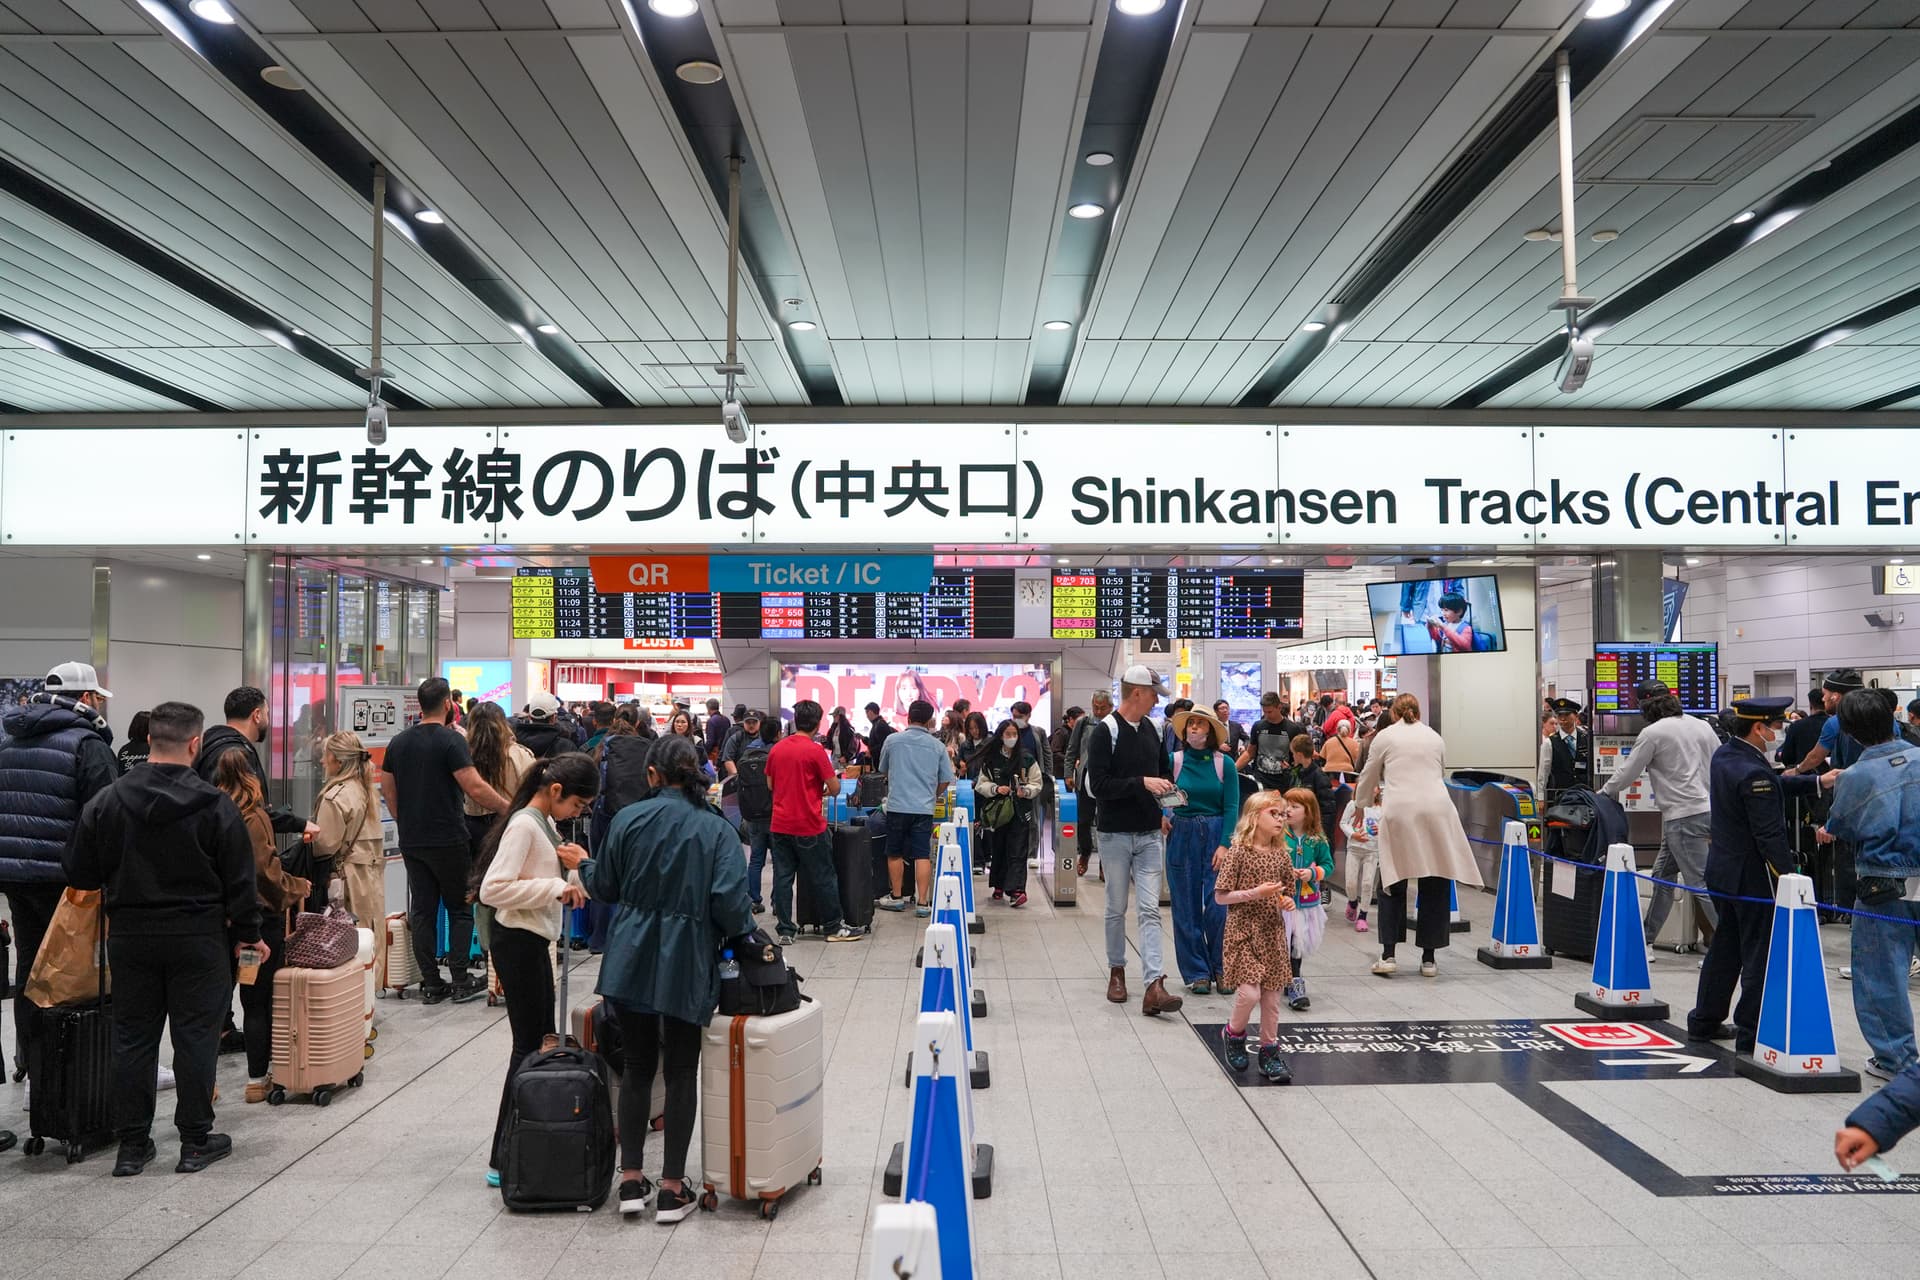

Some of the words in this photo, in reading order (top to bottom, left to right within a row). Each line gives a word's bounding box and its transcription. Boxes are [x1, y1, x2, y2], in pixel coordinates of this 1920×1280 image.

[1071, 476, 1397, 525] Shinkansen
[1425, 478, 1610, 525] Tracks
[1624, 473, 1839, 529] (Central
[628, 563, 669, 586] QR
[748, 563, 829, 584] Ticket
[854, 562, 880, 584] IC
[633, 638, 685, 648] PLUSTA
[1149, 639, 1162, 651] A
[1300, 656, 1309, 664] 24
[1313, 656, 1323, 664] 23
[1327, 656, 1336, 664] 22
[1340, 656, 1349, 664] 21
[1354, 655, 1363, 664] 20
[1063, 859, 1072, 870] 8
[1515, 946, 1529, 954] JR
[1623, 992, 1640, 1001] JR
[1764, 1050, 1777, 1064] JR
[1803, 1057, 1823, 1069] JR
[1713, 1185, 1761, 1193] Line
